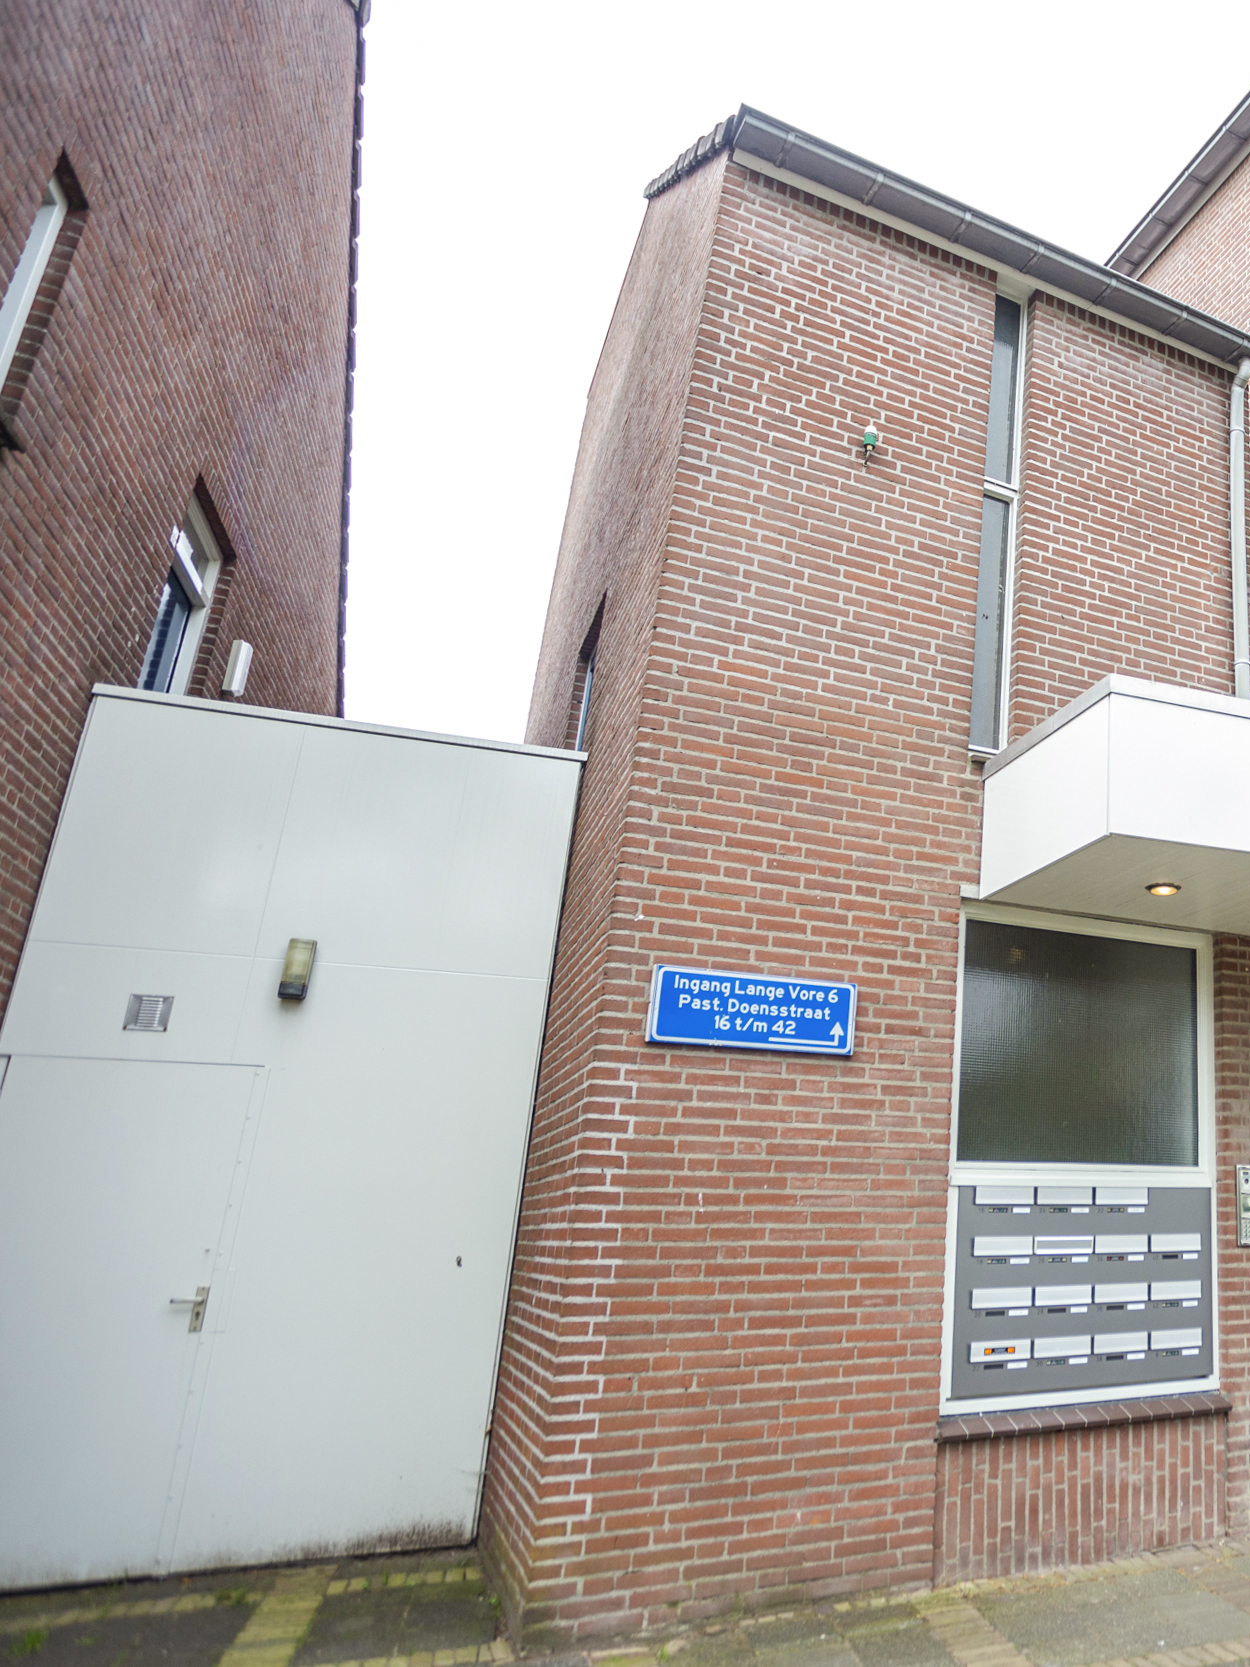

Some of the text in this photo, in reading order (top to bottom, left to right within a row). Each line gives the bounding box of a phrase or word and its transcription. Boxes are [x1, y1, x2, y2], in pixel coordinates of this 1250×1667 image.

[674, 974, 839, 1004] Ingang Lange Vore 6
[678, 994, 831, 1021] Past. Doensstraat
[714, 1015, 796, 1035] 16 t/m 42
